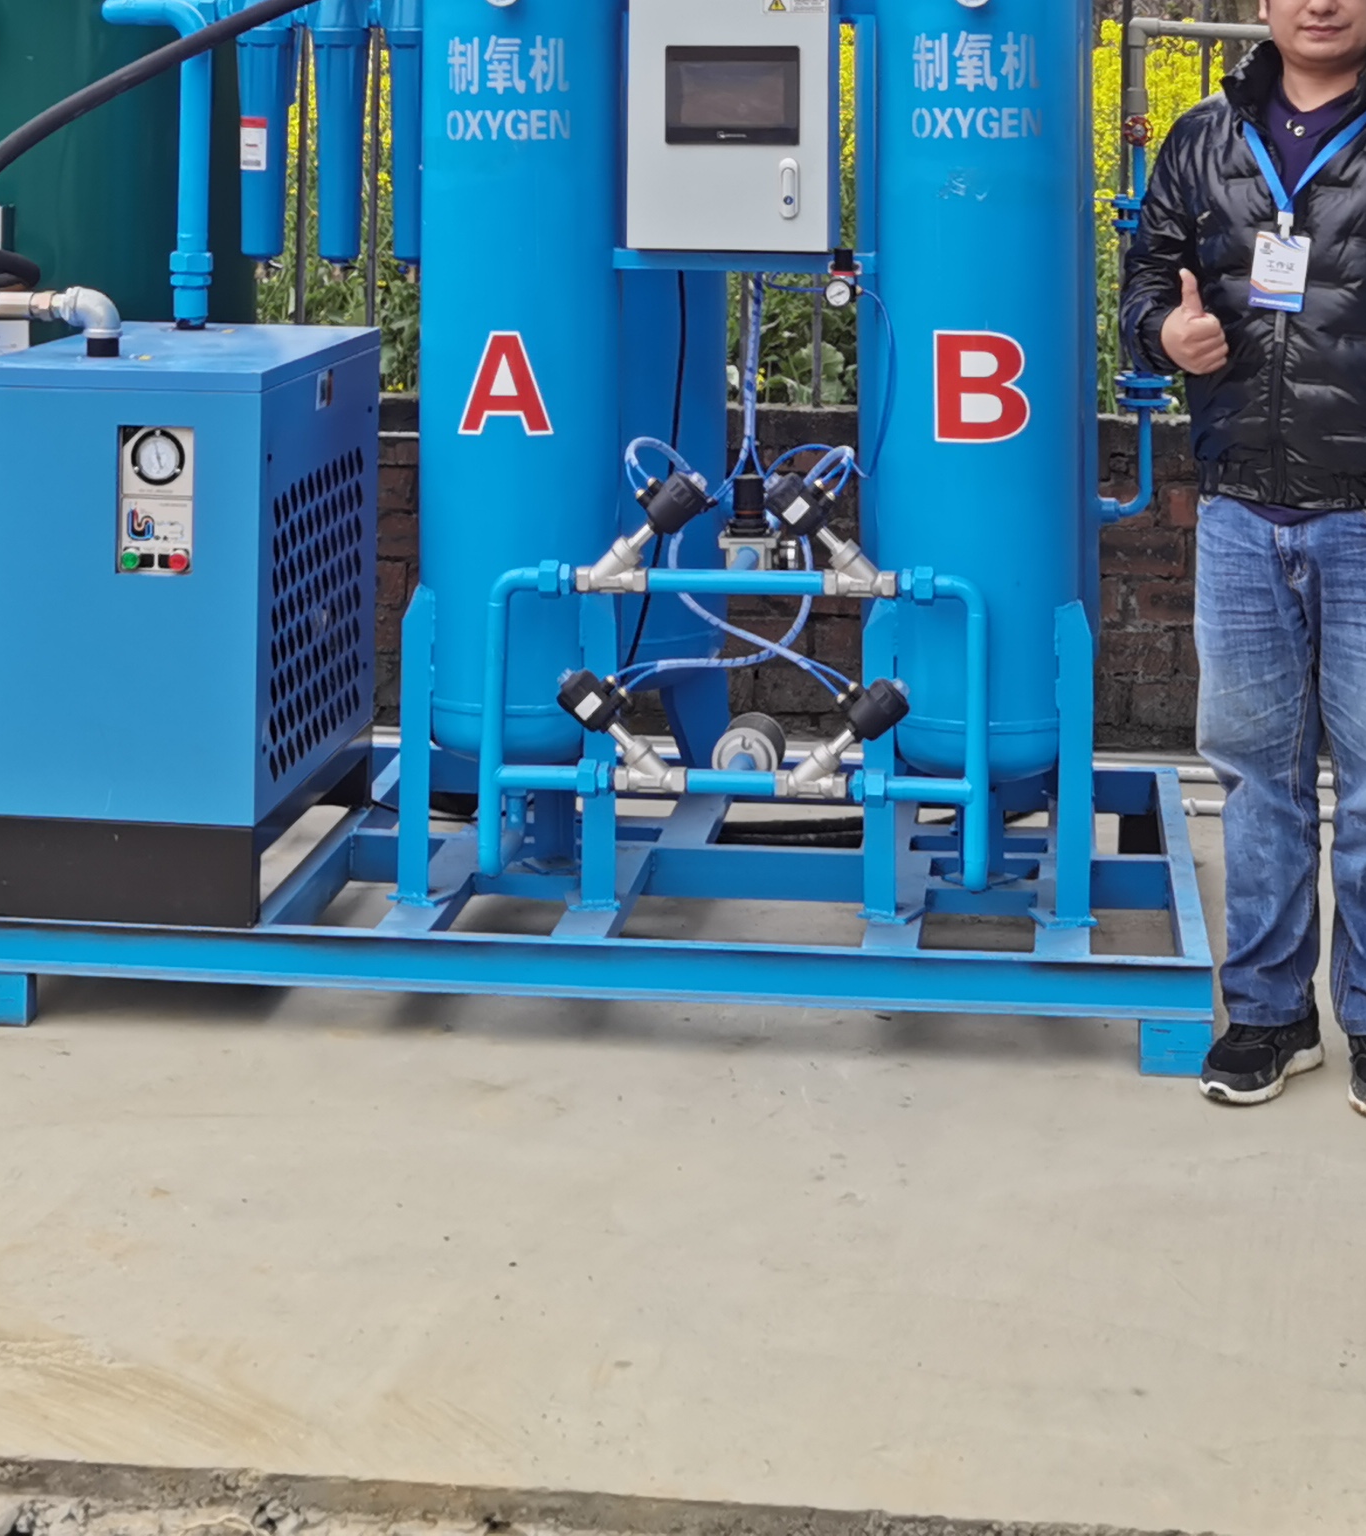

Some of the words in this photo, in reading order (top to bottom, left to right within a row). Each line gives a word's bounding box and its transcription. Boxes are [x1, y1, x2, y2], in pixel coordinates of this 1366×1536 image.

[447, 34, 570, 95] 制氧机
[912, 30, 1040, 92] 制氧机
[447, 109, 571, 141] OXYGEN
[912, 107, 1042, 139] OXYGEN
[458, 331, 554, 436] A
[933, 330, 1030, 443] B
